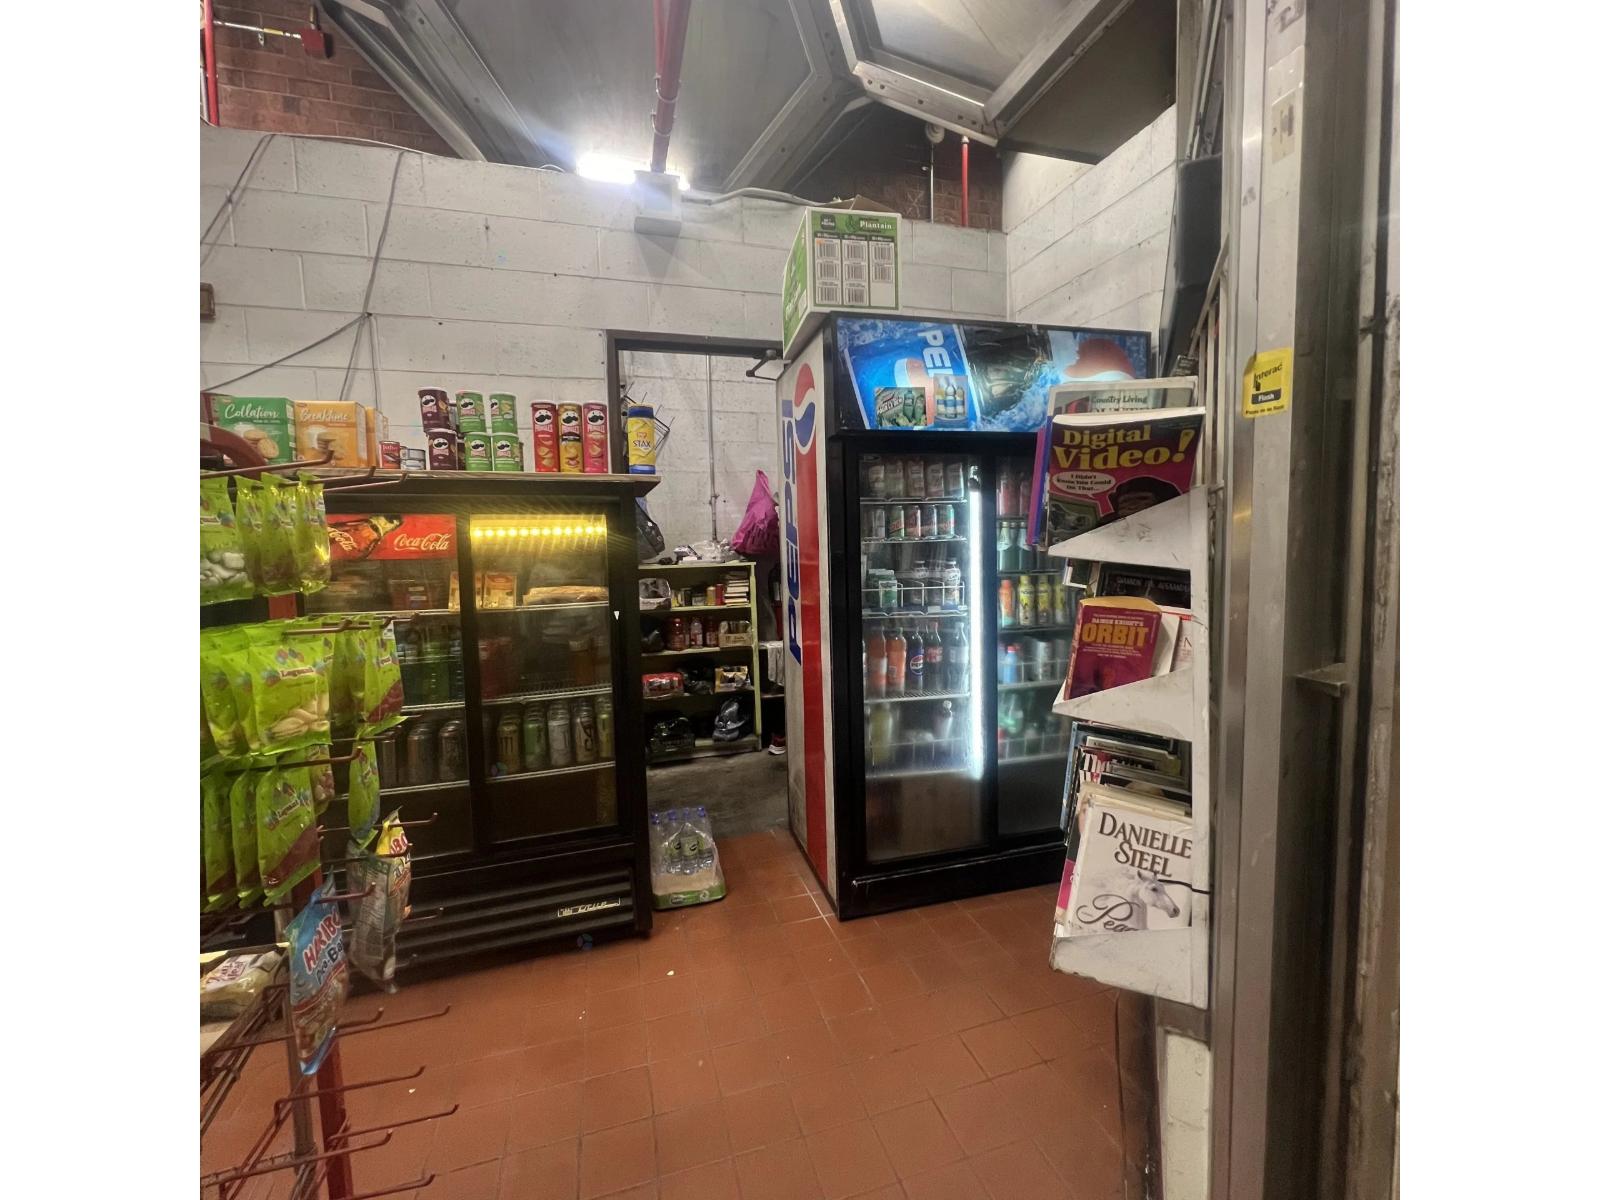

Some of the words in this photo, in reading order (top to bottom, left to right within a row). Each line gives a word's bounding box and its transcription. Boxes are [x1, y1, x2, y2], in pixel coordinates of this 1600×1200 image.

[859, 220, 893, 231] Plantain
[225, 402, 279, 419] Collation
[1122, 394, 1148, 404] Living
[632, 439, 651, 448] STAX
[1053, 428, 1196, 471] Video!
[1062, 424, 1151, 450] Digital
[782, 399, 802, 667] PEPSI
[1081, 622, 1149, 648] ORBIT
[1098, 811, 1193, 859] DANIELLE
[1113, 840, 1172, 878] STEEL
